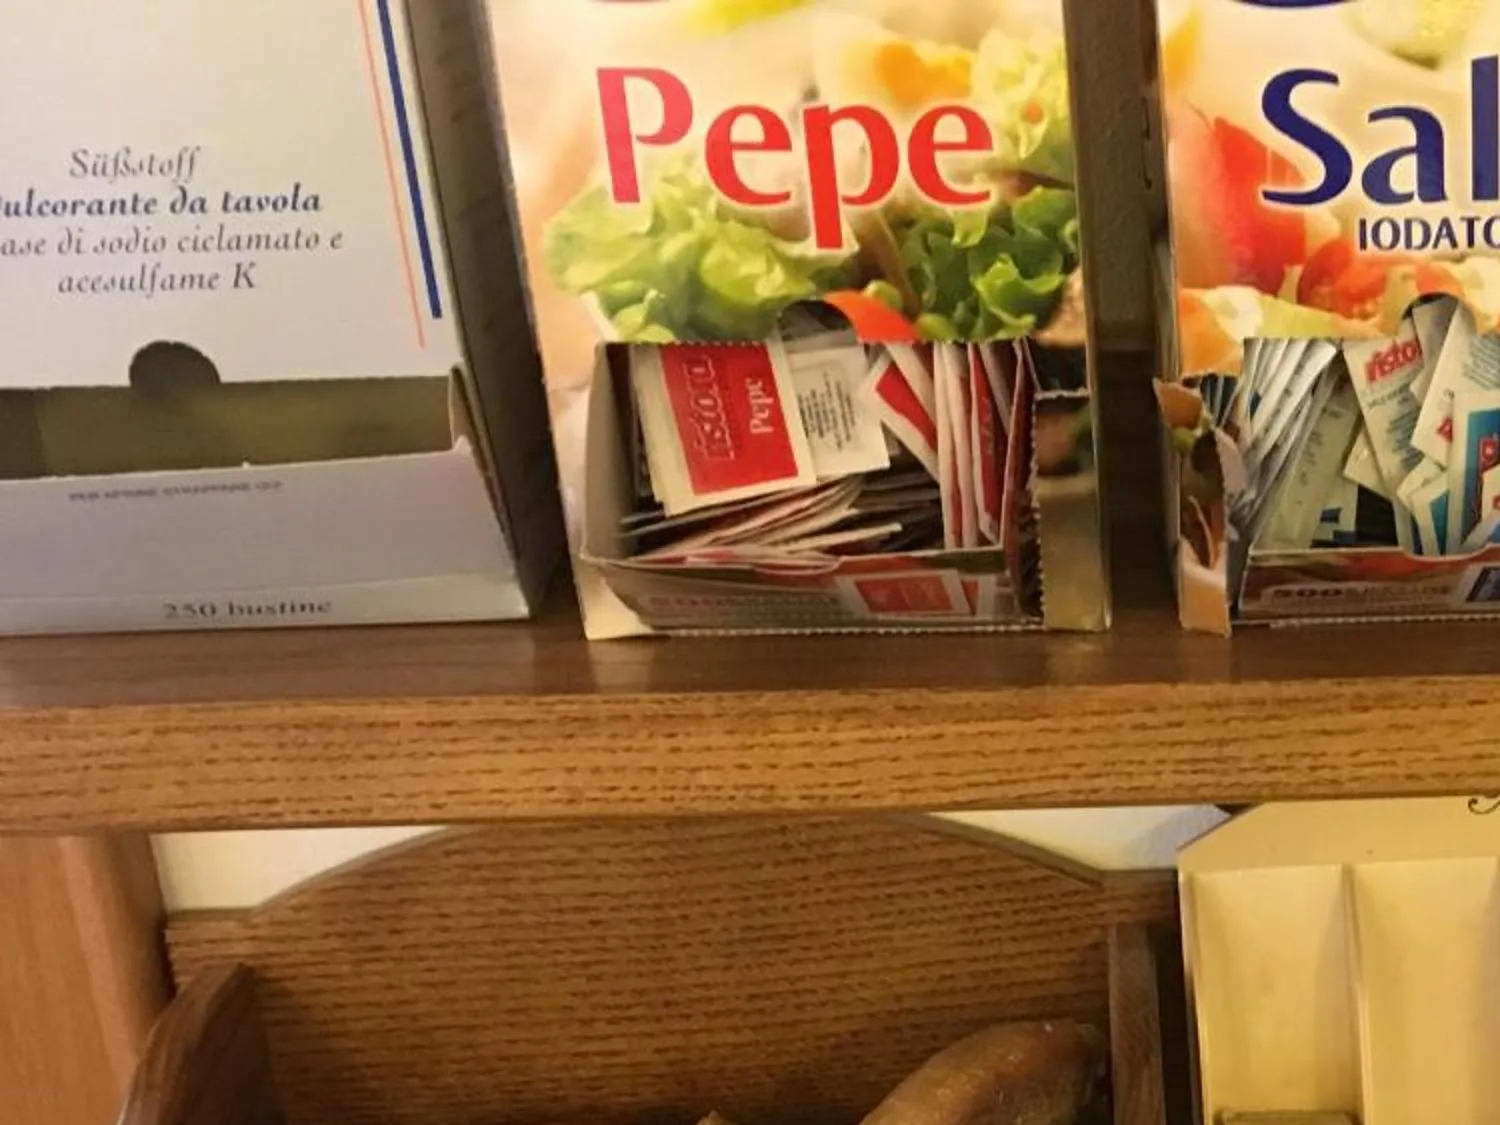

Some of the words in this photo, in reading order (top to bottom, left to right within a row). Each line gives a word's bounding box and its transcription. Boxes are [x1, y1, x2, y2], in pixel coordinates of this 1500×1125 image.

[69, 145, 200, 184] Süßstoff
[597, 68, 993, 249] Pepe
[0, 187, 158, 218] ulcorante
[169, 185, 208, 215] da
[221, 182, 322, 213] tavola
[57, 227, 84, 254] di
[92, 226, 167, 254] sodio
[177, 223, 320, 253] ciclamato
[330, 230, 344, 250] e
[58, 262, 220, 300] acesulfame
[233, 262, 257, 289] K
[745, 377, 774, 434] Pepe
[164, 602, 217, 619] 250
[227, 600, 332, 617] bustine
